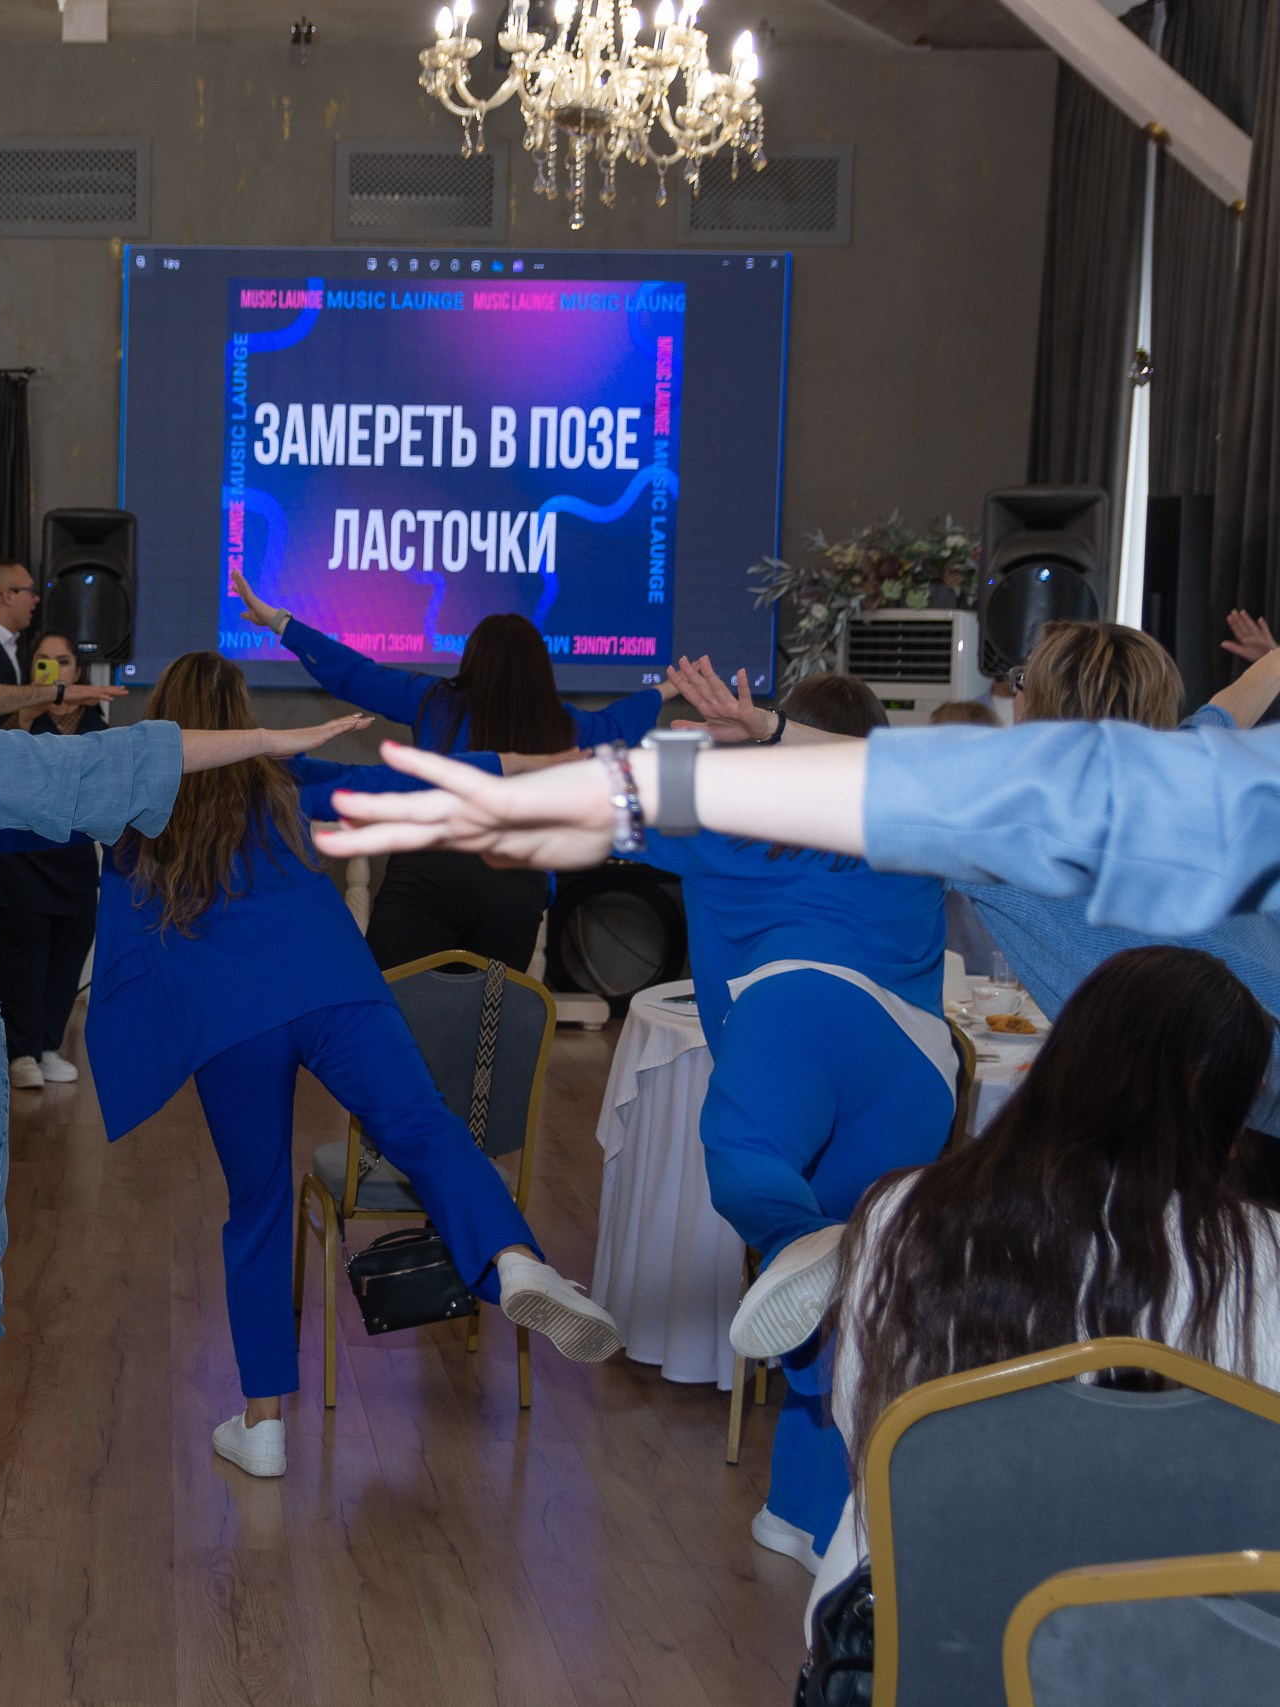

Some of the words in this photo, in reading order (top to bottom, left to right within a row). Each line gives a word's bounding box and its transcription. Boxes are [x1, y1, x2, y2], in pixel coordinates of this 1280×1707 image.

[240, 289, 277, 309] MUSIC
[278, 290, 324, 309] LAUNGE
[326, 290, 387, 309] MUSIC
[390, 291, 465, 311] LAUNGE
[473, 291, 510, 310] MUSIC
[511, 292, 558, 311] LAUNGE
[559, 292, 620, 311] MUSIC
[231, 331, 249, 420] LAUNGE
[656, 336, 673, 381] MUSIC
[654, 382, 671, 436] LAUNGE
[253, 402, 477, 469] ЗАМЕРЕТЬ
[489, 405, 517, 469] В
[528, 406, 641, 471] ПОЗЕ
[230, 424, 247, 495] MUSIC
[228, 499, 244, 553] LAUNGE
[328, 508, 557, 574] ЛАСТОЧКИ
[648, 516, 667, 604] LAUNGE
[387, 633, 424, 653] MUSIC
[572, 635, 618, 655] LAUNGE
[619, 636, 657, 656] MUSIC
